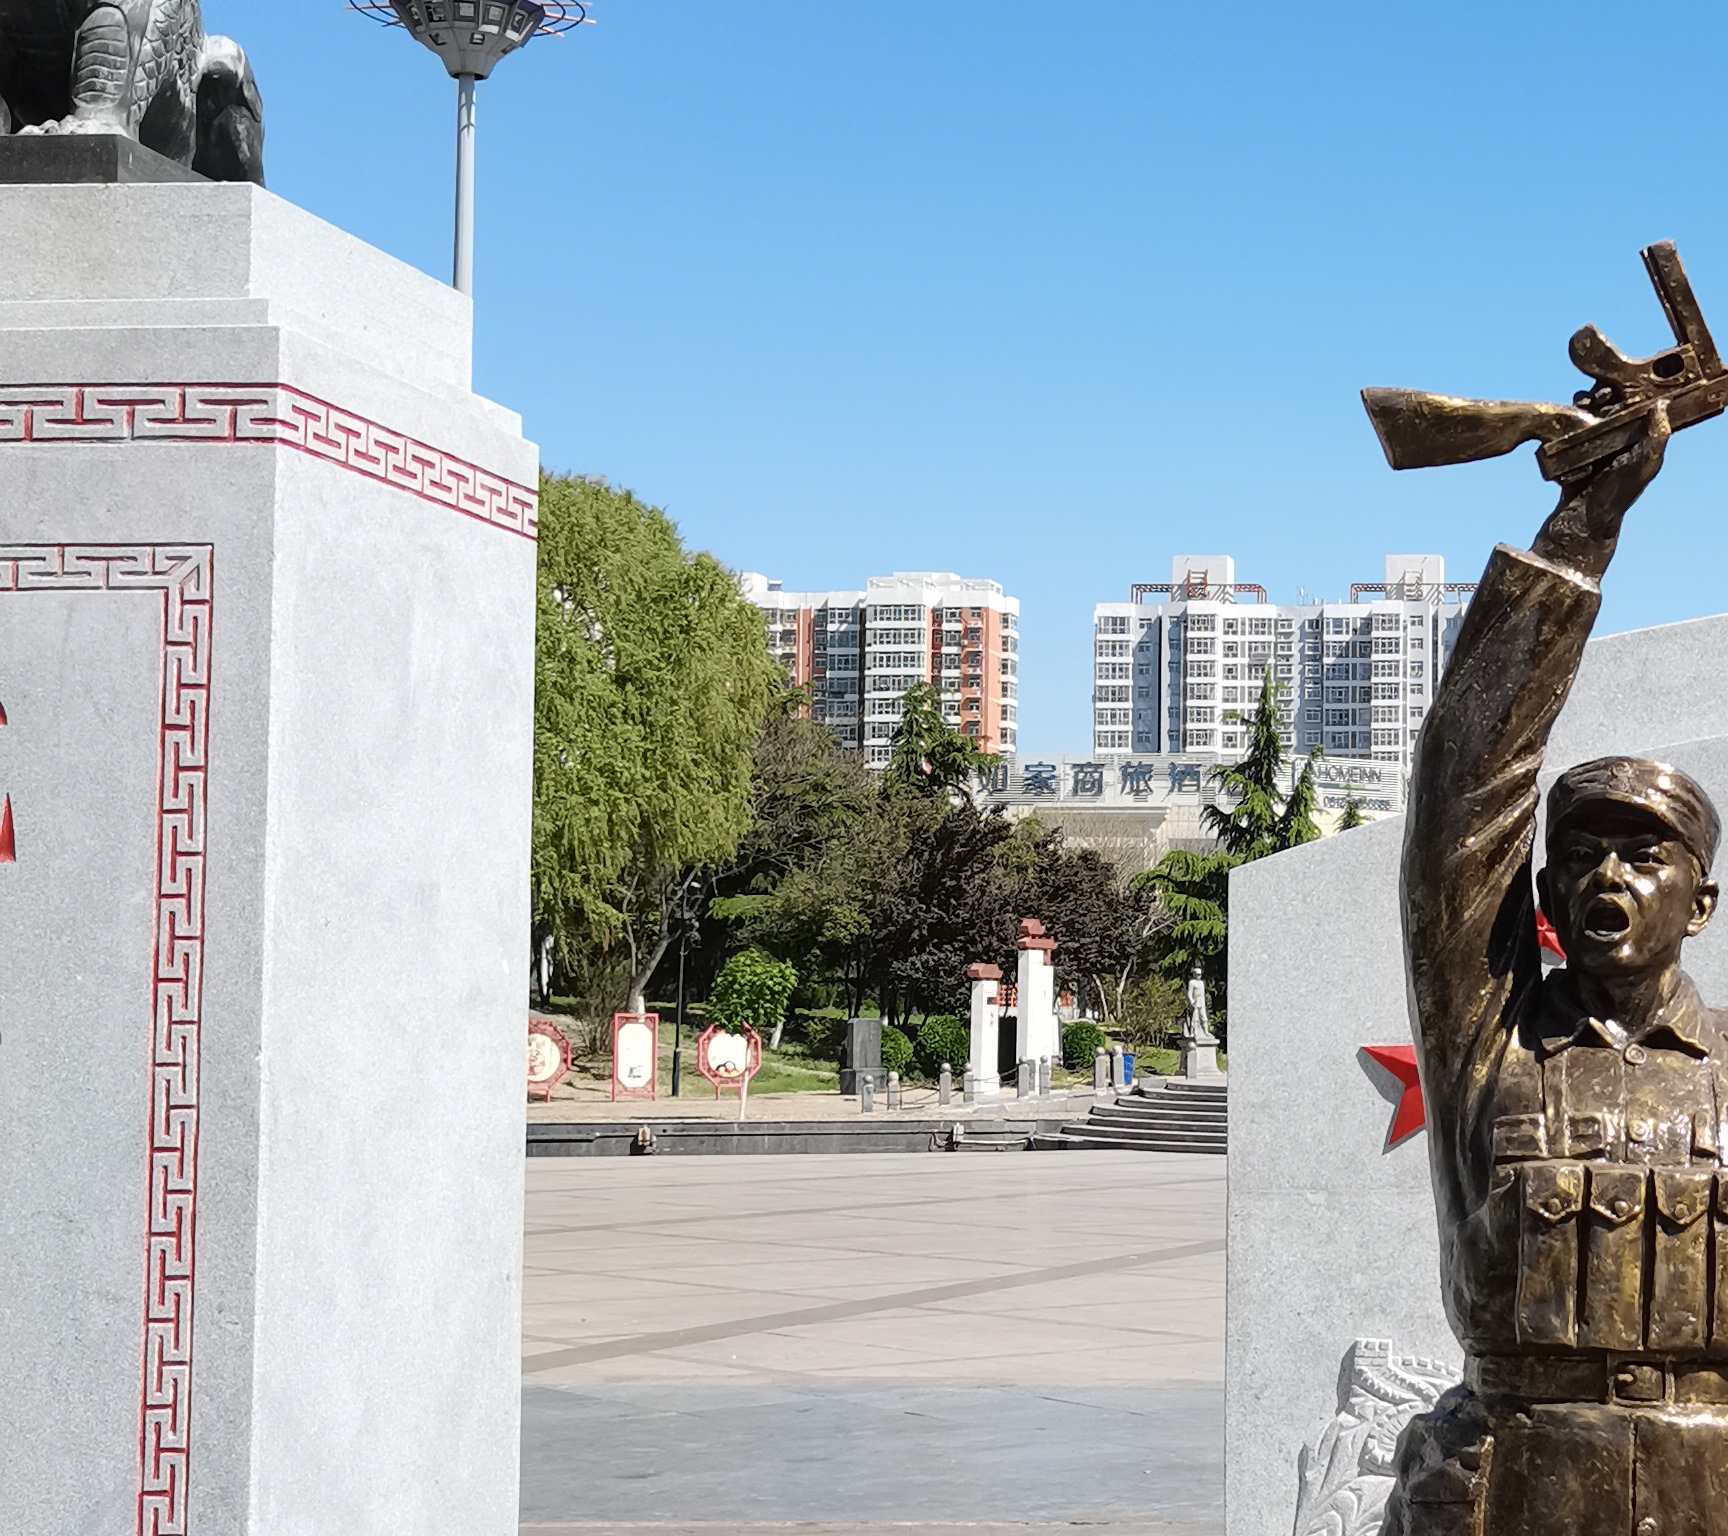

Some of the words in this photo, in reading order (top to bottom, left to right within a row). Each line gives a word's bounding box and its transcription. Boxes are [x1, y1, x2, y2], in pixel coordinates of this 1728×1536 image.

[975, 761, 1243, 798] 如家商旅酒
